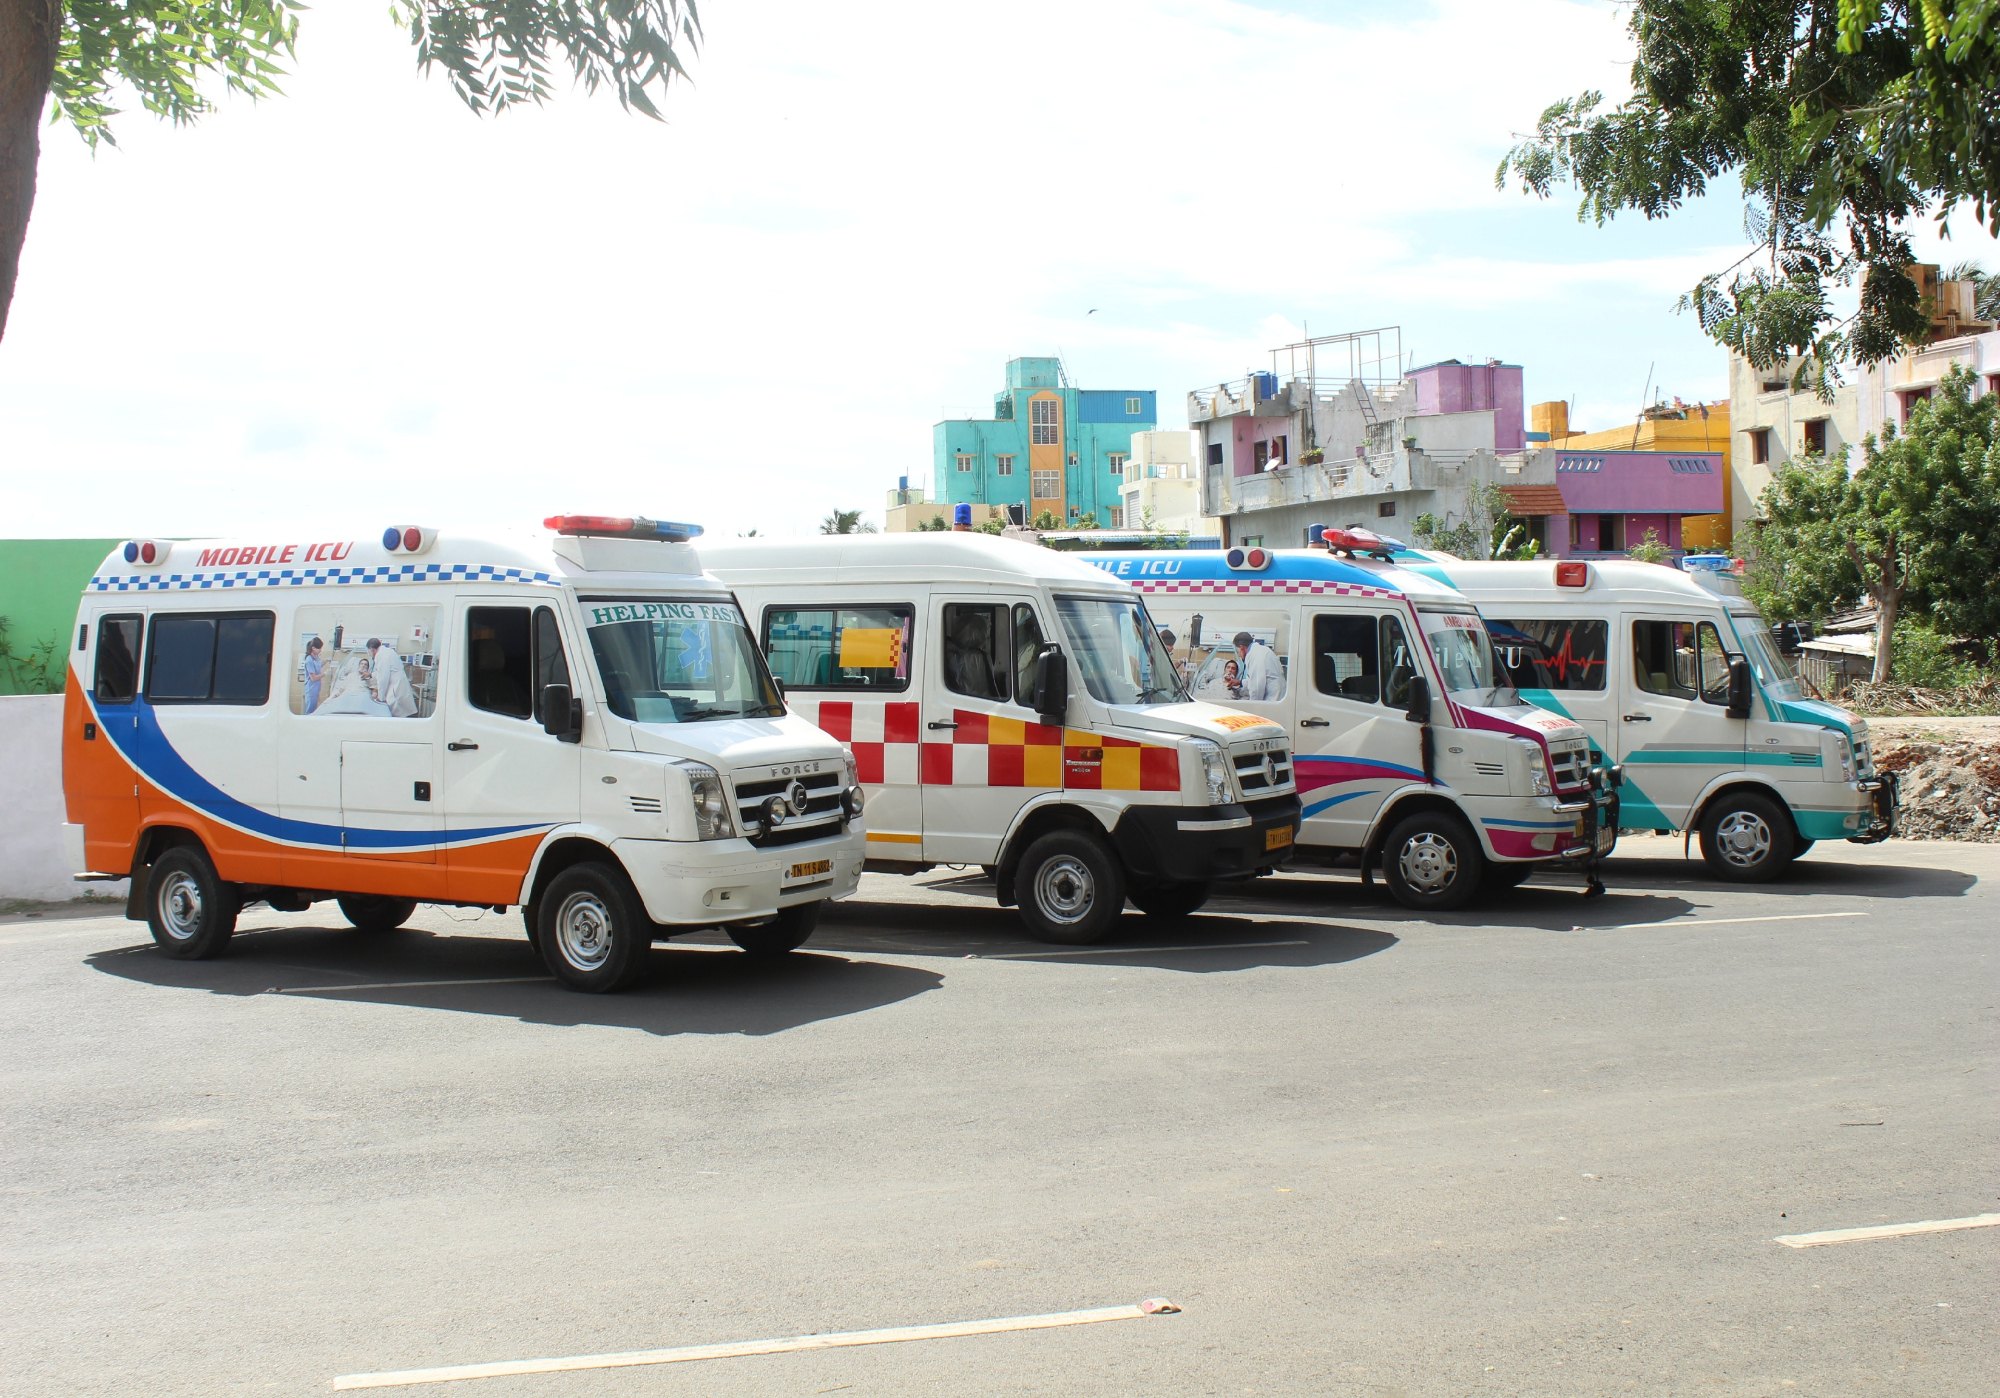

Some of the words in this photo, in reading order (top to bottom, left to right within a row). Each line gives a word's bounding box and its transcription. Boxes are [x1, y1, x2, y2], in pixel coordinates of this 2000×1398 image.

[196, 544, 298, 567] MOBILE
[304, 541, 354, 562] ICU
[1091, 560, 1132, 575] ILE
[1140, 560, 1182, 575] ICU
[592, 603, 695, 625] HELPING
[698, 604, 740, 625] FAST
[771, 762, 819, 777] FORCE
